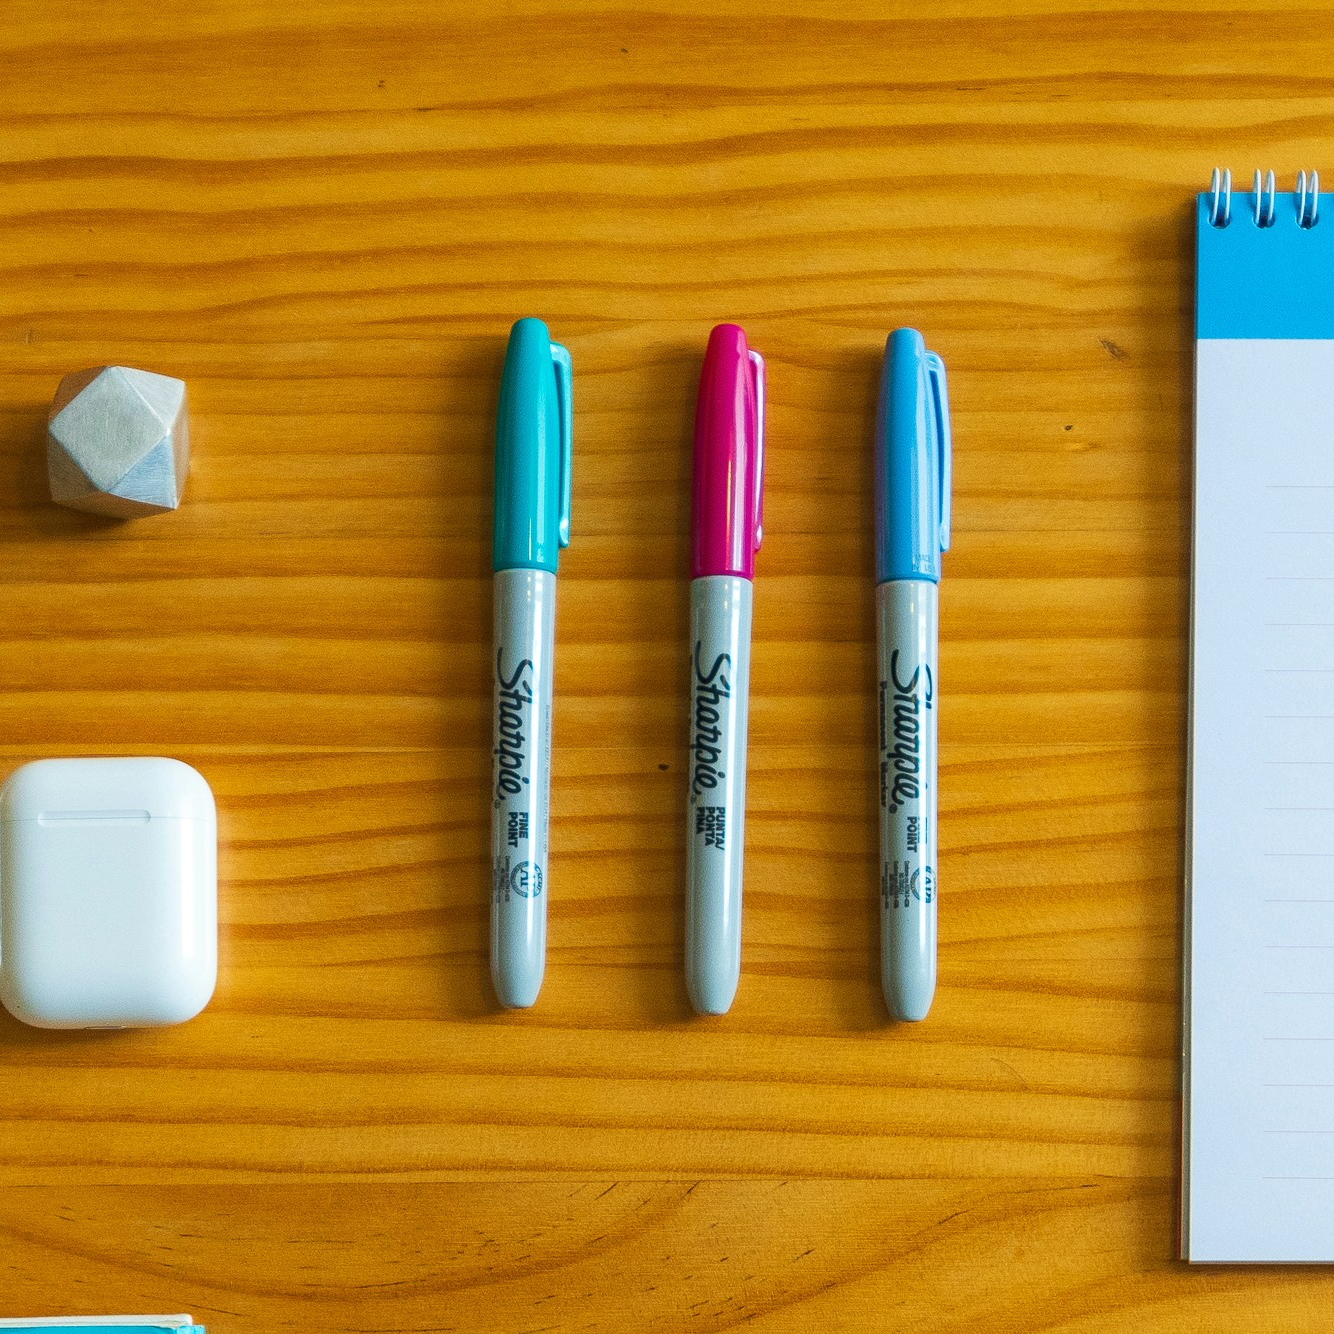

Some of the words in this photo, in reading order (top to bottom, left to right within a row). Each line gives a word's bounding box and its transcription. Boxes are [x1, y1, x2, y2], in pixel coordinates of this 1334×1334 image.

[493, 647, 534, 801] Sharpie
[690, 640, 732, 796] Sharpie
[508, 811, 519, 848] POINT
[519, 811, 529, 839] FINE
[705, 807, 715, 846] PONTA
[907, 816, 917, 853] POINT
